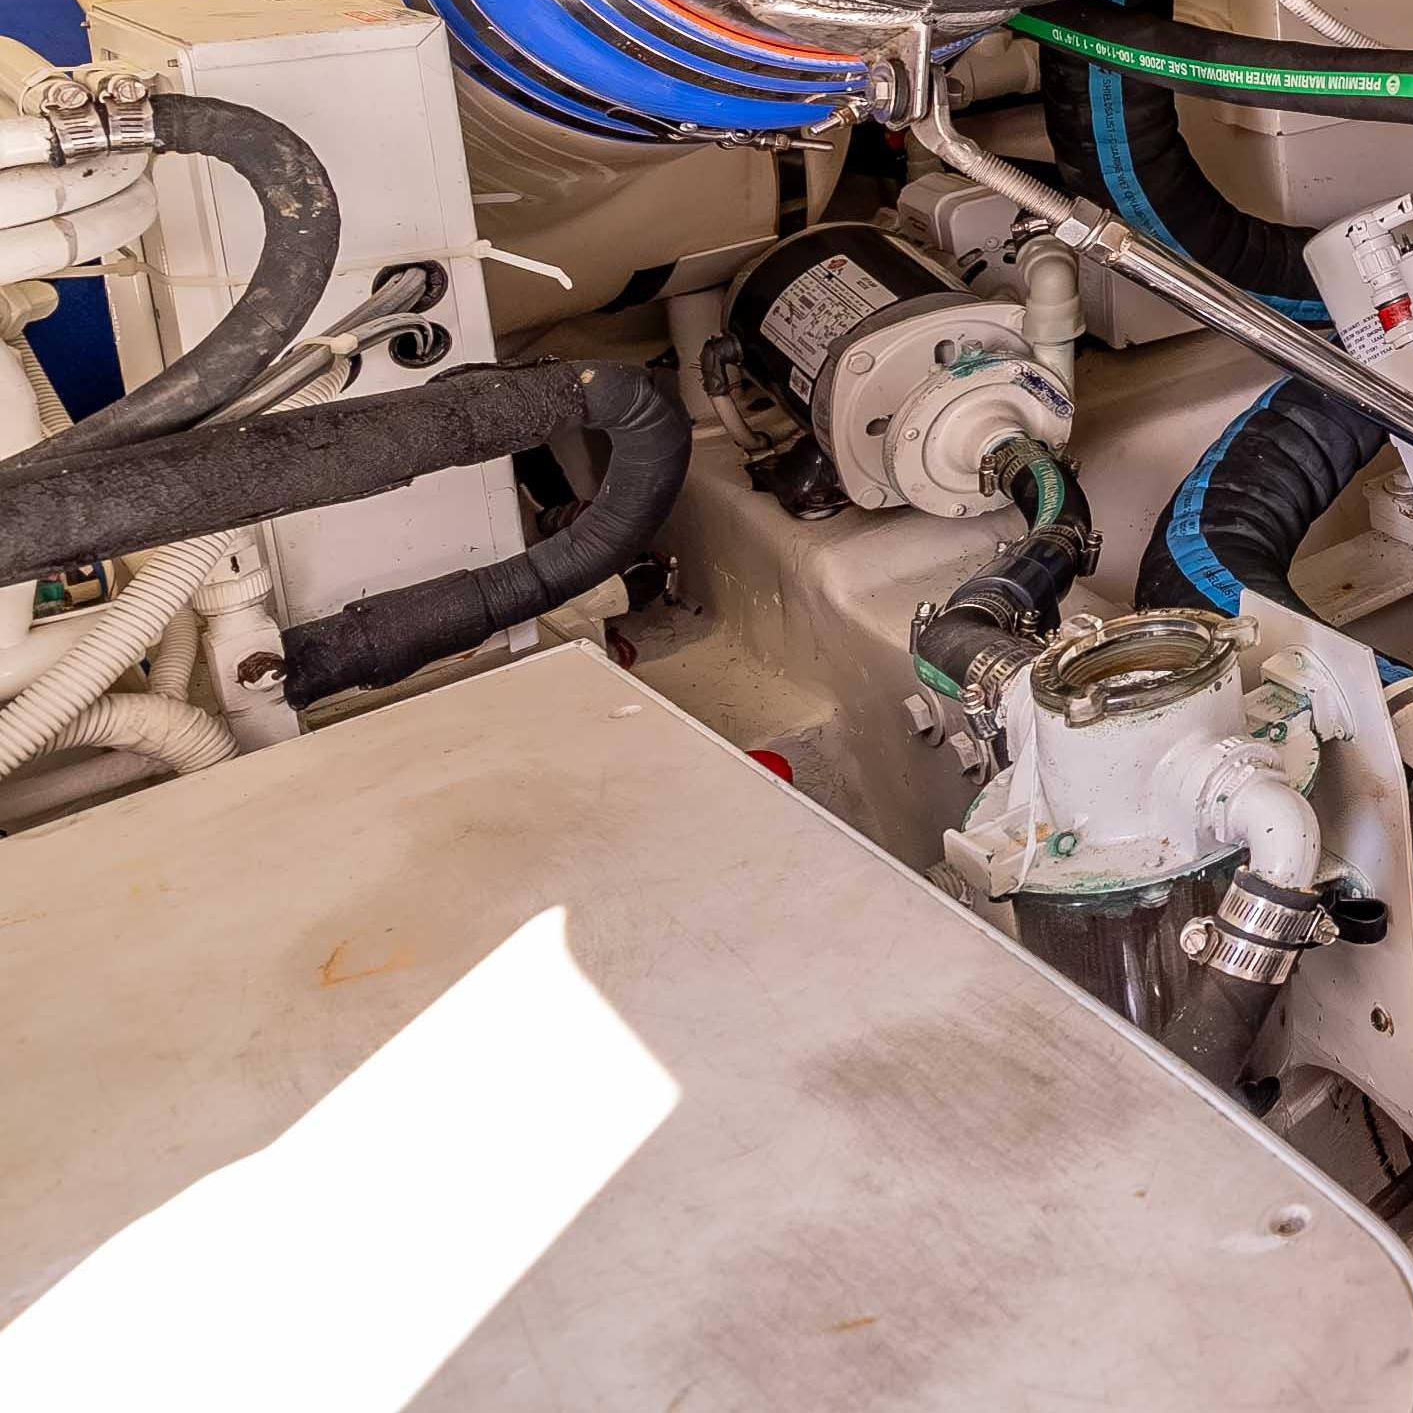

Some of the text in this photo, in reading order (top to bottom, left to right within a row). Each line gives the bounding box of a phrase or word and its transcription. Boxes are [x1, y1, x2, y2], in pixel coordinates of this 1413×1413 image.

[1096, 44, 1136, 64] 100-1140
[1139, 54, 1166, 71] J2006
[1167, 60, 1189, 76] SAE
[1189, 64, 1244, 85] HARDWALL
[1245, 71, 1282, 87] WATER
[1283, 74, 1326, 90] MARINE
[1328, 76, 1382, 91] PREMIUM
